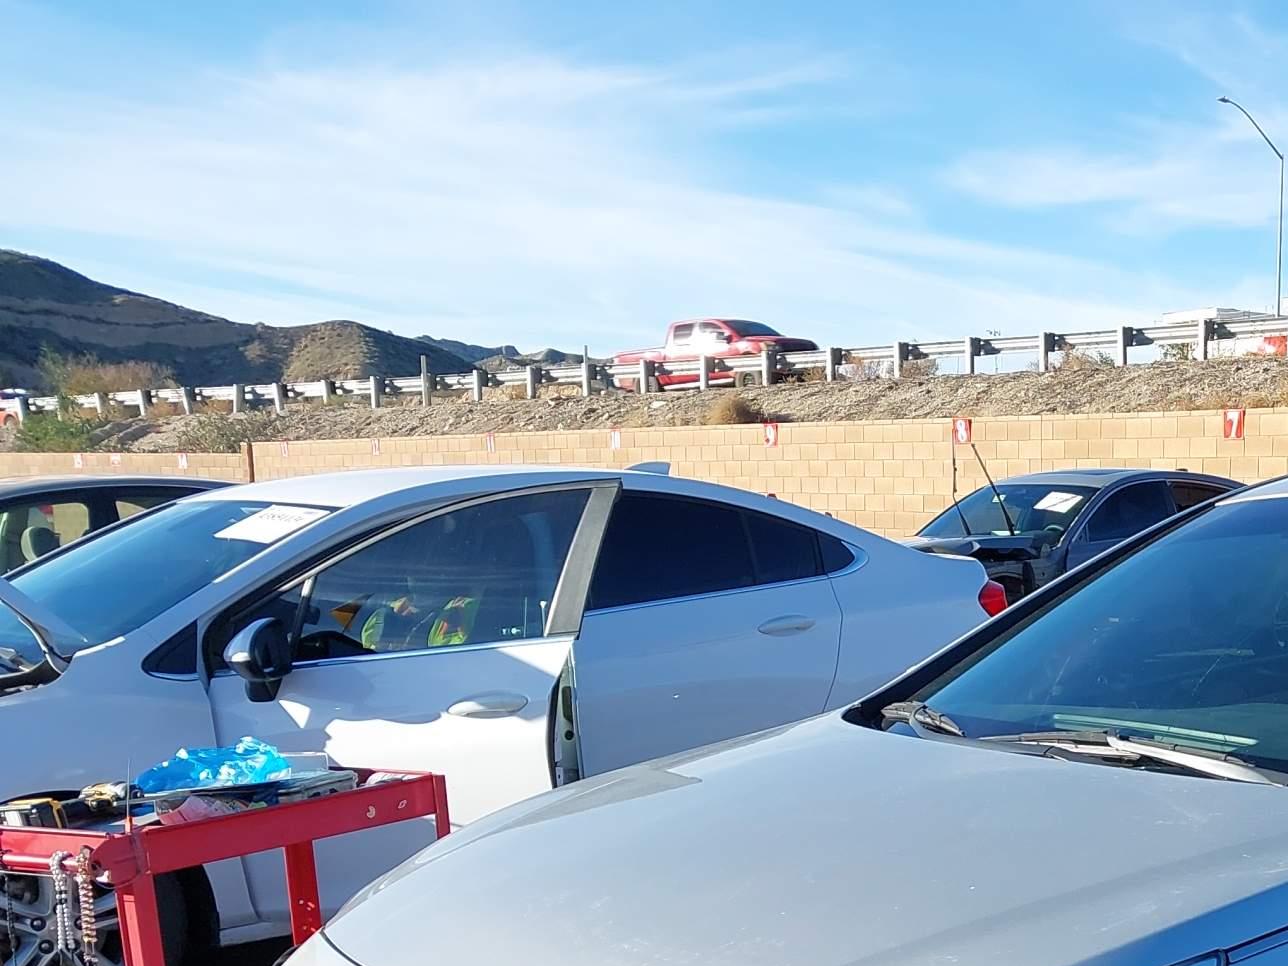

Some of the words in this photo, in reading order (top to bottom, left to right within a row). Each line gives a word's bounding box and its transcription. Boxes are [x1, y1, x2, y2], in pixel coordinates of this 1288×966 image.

[956, 419, 968, 442] 8
[1226, 410, 1241, 438] 7
[764, 425, 775, 447] 9
